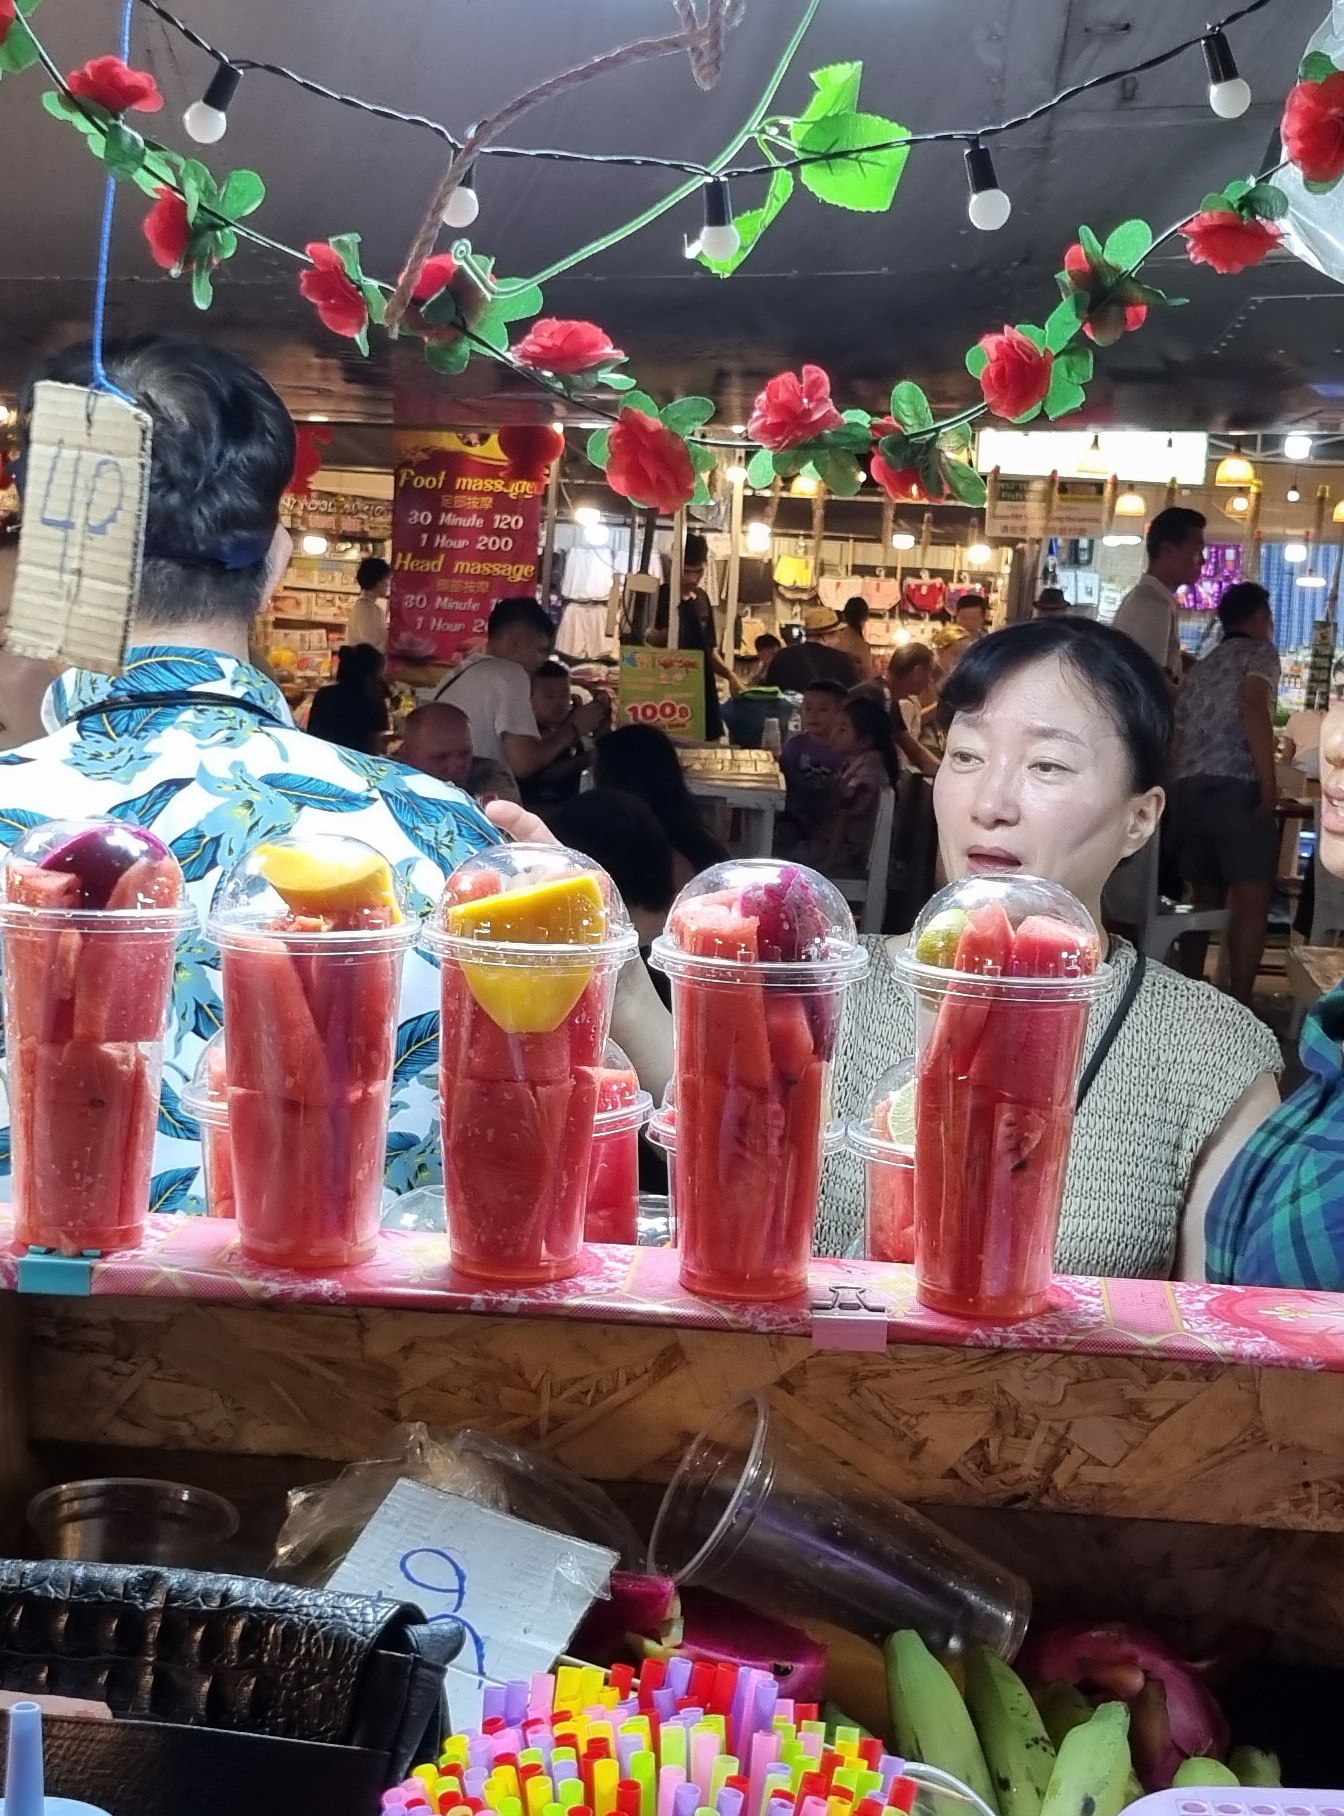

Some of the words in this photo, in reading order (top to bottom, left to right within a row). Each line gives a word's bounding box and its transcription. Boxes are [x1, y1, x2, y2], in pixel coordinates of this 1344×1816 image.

[398, 468, 446, 489] Foot
[408, 510, 432, 526] 30
[439, 512, 484, 528] Minute
[493, 515, 524, 530] 120
[420, 533, 428, 547] 1
[434, 534, 470, 549] Hour
[477, 536, 513, 551] 200
[394, 552, 445, 573] Head
[453, 560, 536, 583] massage
[405, 594, 427, 609] 30
[435, 596, 481, 611] Minute
[416, 616, 424, 630] 1
[430, 617, 466, 632] Hour
